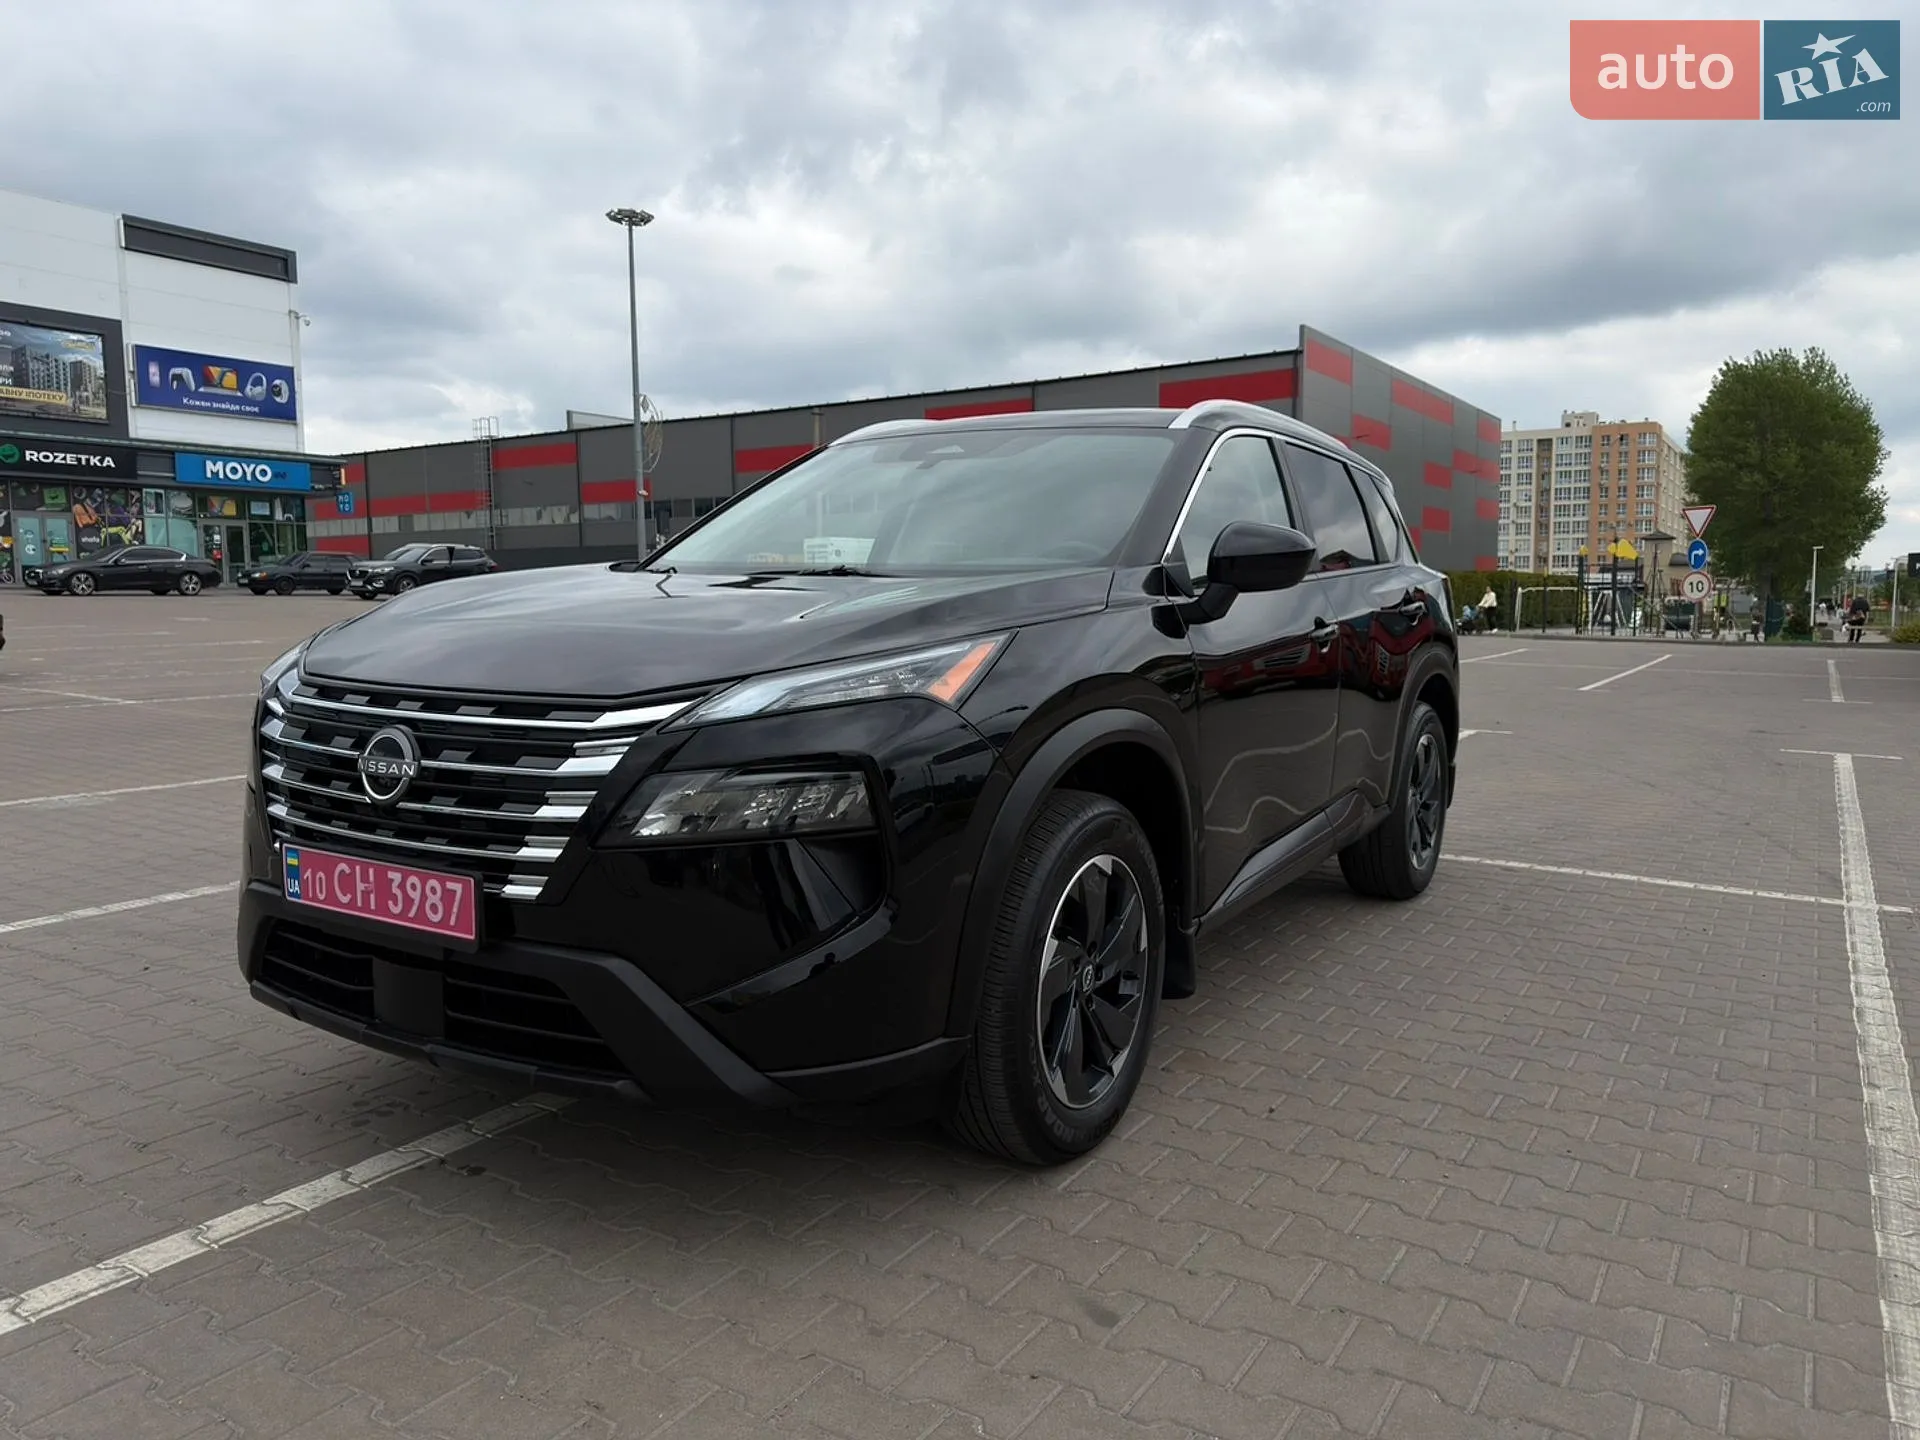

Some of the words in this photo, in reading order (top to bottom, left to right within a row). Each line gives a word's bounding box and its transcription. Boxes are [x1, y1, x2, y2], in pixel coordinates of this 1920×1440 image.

[24, 449, 116, 468] ROZETKA
[205, 459, 273, 483] MOYO
[1689, 580, 1704, 593] 10
[357, 757, 415, 776] NISSAN
[287, 876, 301, 894] UA
[303, 868, 326, 901] 10
[333, 862, 376, 911] CH
[387, 870, 463, 927] 3987
